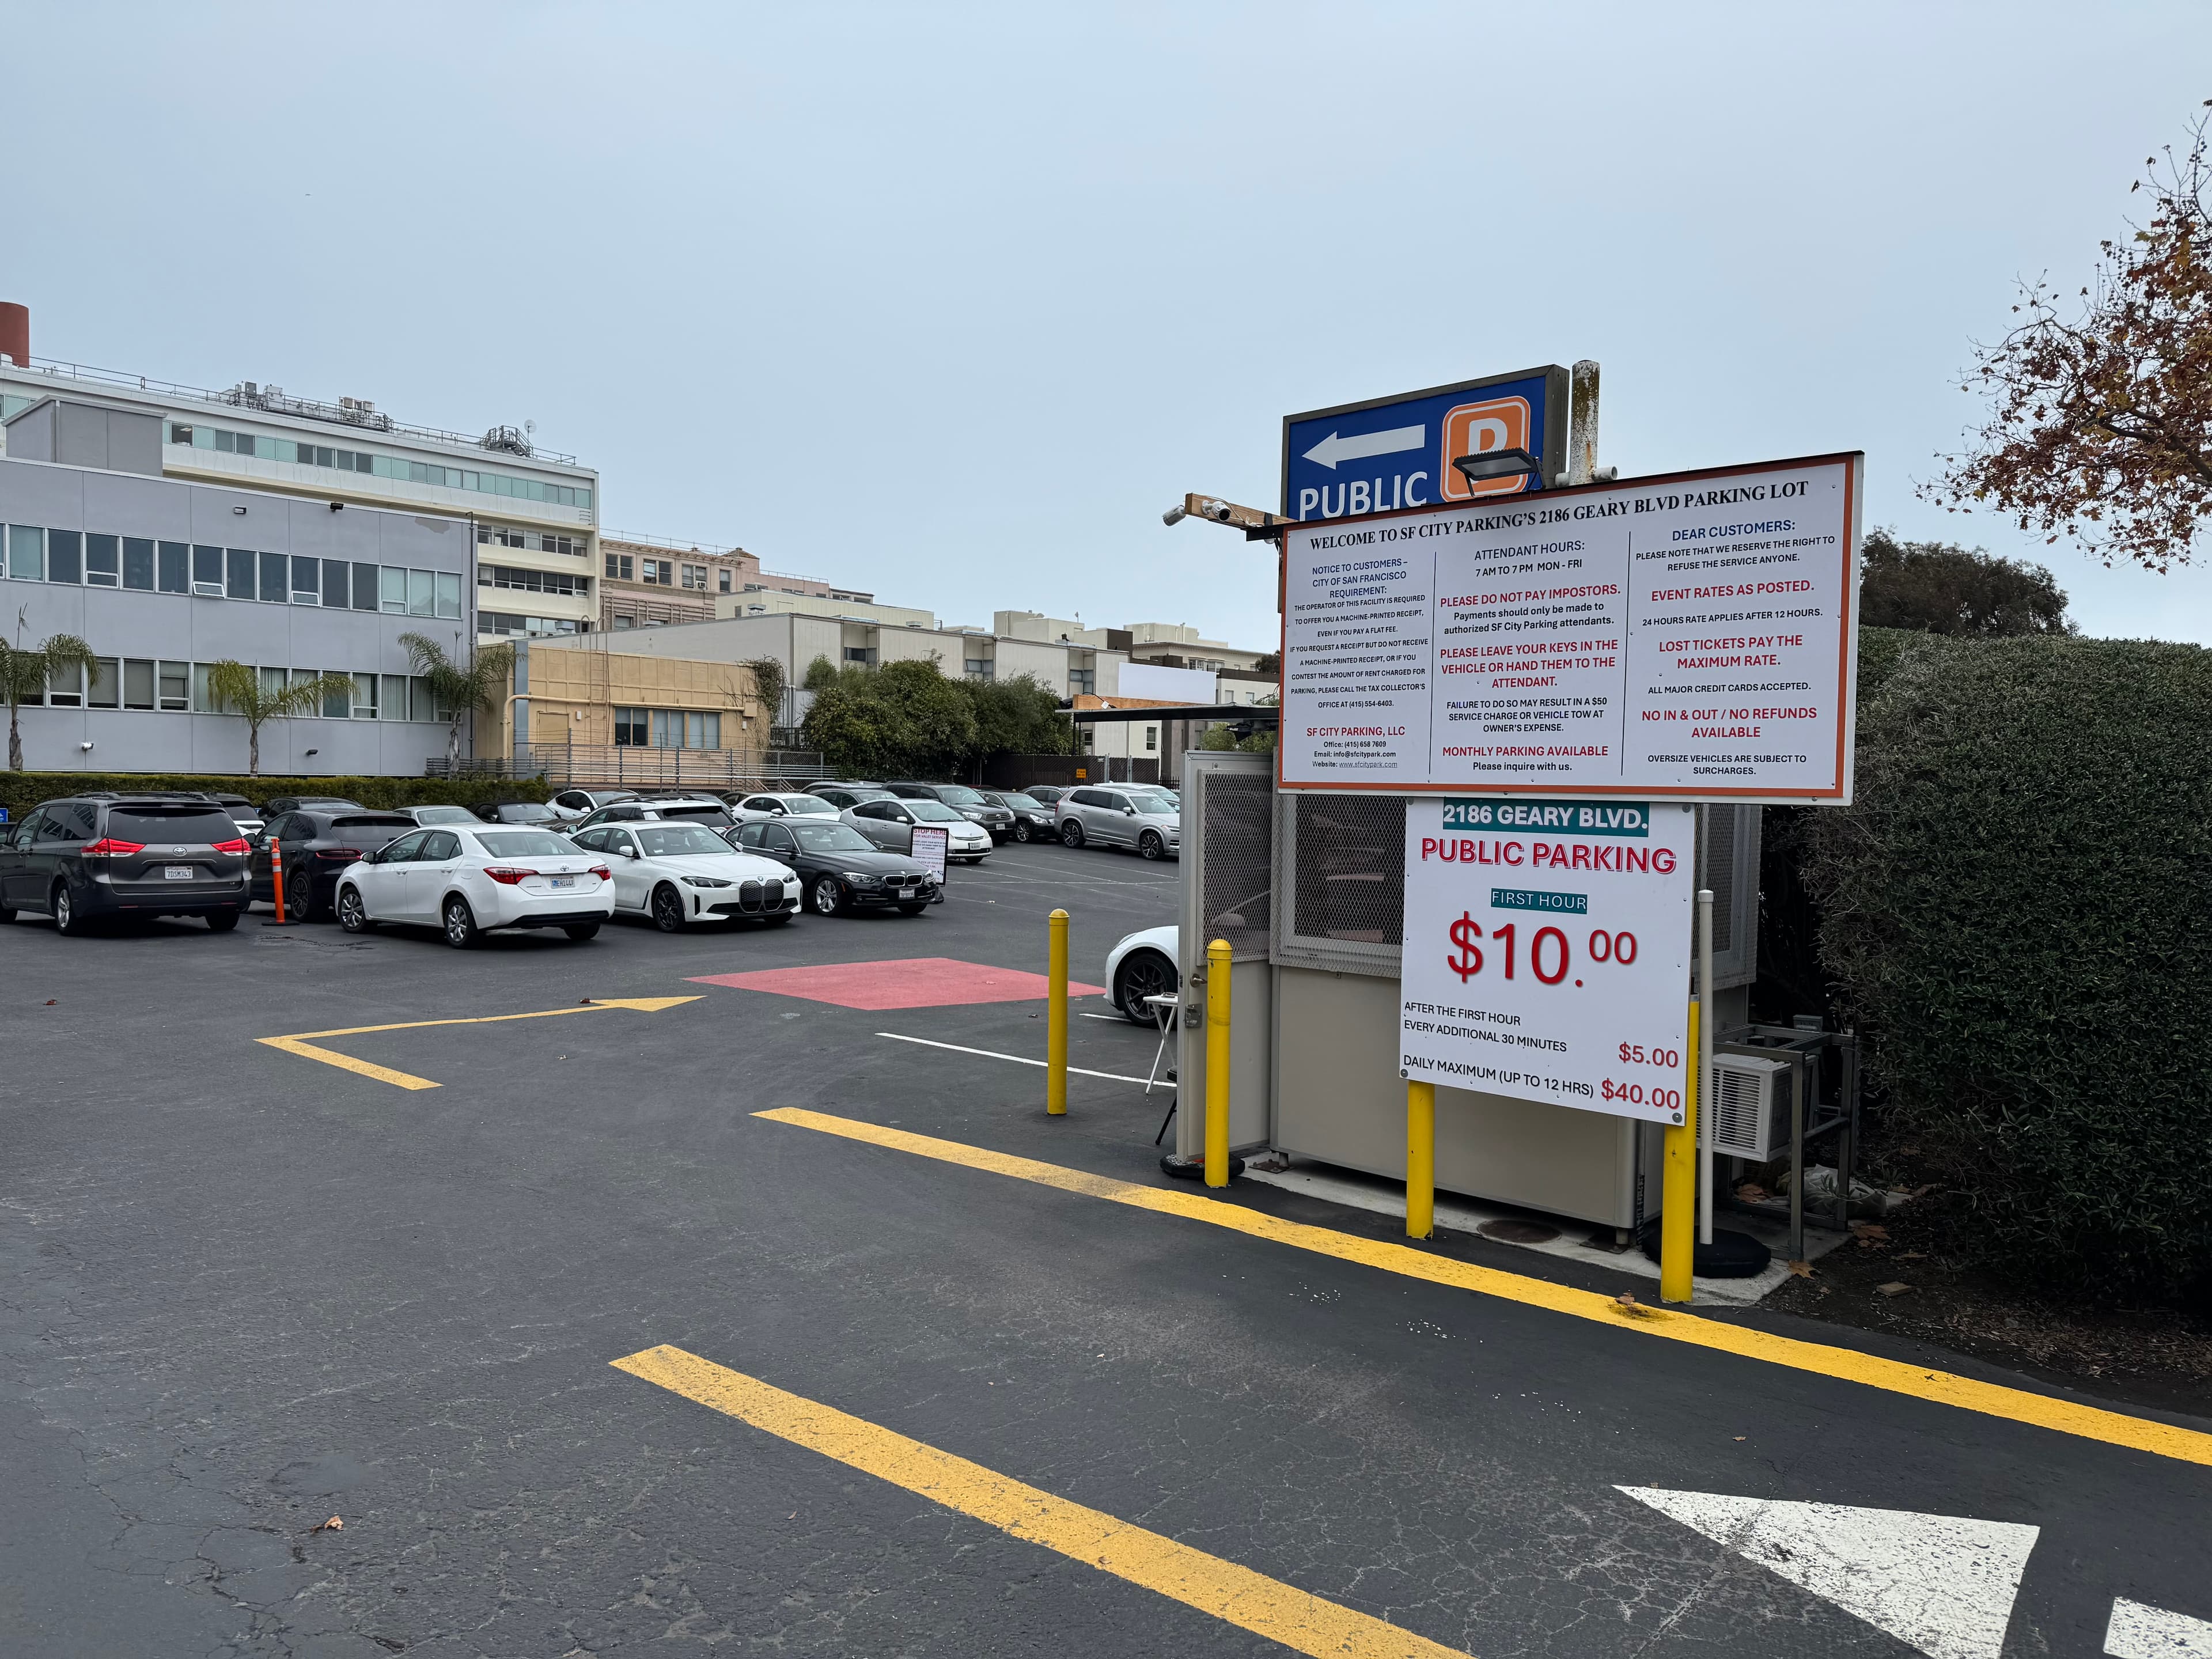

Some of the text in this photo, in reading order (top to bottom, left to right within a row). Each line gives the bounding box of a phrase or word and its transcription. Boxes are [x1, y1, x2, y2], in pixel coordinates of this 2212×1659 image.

[1468, 417, 1508, 484] P
[1300, 471, 1428, 521] PUBLIC
[1310, 480, 1809, 550] WELCOME TO SF CITY PARKING'S 2186 GEARY BLVD PARKING LOT
[1673, 520, 1795, 541] DEAR CUSTOMERS:
[1475, 541, 1584, 560] ATTENDANT HOURS:
[1313, 565, 1339, 574] NOTICE
[1341, 563, 1351, 572] TO
[1354, 559, 1402, 570] CUSTOMERS
[1475, 569, 1481, 577] 7
[1483, 567, 1495, 576] AM
[1498, 566, 1509, 574] TO
[1512, 565, 1517, 574] 7
[1520, 564, 1533, 573] PM
[1537, 561, 1559, 571] MON
[1568, 559, 1582, 568] FRI
[1313, 571, 1406, 587] CITY OF SAN FRANCISCO
[1330, 586, 1387, 599] REQUIREMENT:
[1441, 584, 1620, 607] PLEASE DO NOT PAY IMPOSTORS.
[1652, 580, 1814, 601] EVENT RATES AS POSTED.
[1306, 602, 1336, 611] OPERATOR
[1360, 598, 1386, 606] FACILITY
[1394, 595, 1425, 603] REQUIRED
[1441, 640, 1618, 658] PLEASE LEAVE YOUR KEYS IN THE
[1660, 635, 1802, 652] LOST TICKETS PAY THE
[1442, 657, 1615, 674] VEHICLE OR HAND THEM TO THE
[1678, 654, 1780, 668] MAXIMUM RATE.
[1493, 676, 1557, 688] ATTENDANT.
[1647, 683, 1810, 694] ALL MAJOR CREDIT CARDS ACCEPTED.
[1349, 700, 1364, 709] (415)
[1642, 711, 1660, 721] NO
[1664, 710, 1676, 720] IN
[1680, 710, 1688, 719] &
[1692, 710, 1718, 719] OUT
[1730, 709, 1749, 719] NO
[1753, 707, 1816, 719] REFUNDS
[1307, 726, 1404, 737] SF CITY PARKING, LLC
[1692, 727, 1760, 737] AVAILABLE
[1344, 741, 1359, 749] (415)
[1443, 746, 1608, 756] MONTHLY PARKING AVAILABLE
[1333, 751, 1396, 759] info@sfcitypark.com
[1690, 755, 1733, 763] VEHICLES
[1734, 755, 1752, 763] ARE
[1753, 755, 1793, 763] SUBJECT
[1794, 755, 1806, 763] TO
[1473, 762, 1502, 770] Please
[1504, 762, 1535, 772] inquire
[1537, 762, 1556, 770] with
[1693, 767, 1756, 775] SURCHARGES.
[1443, 802, 1649, 830] 2186 GEARY BLVD.
[1422, 838, 1676, 874] PUBLIC PARKING
[1491, 892, 1586, 909] FIRST HOUR
[1405, 1002, 1520, 1025] AFTER THE FIRST HOUR
[1405, 1020, 1566, 1051] EVERY ADDITIONAL 30 MINUTES
[1619, 1043, 1678, 1067] $5.00
[1404, 1055, 1593, 1099] DAILY MAXIMUM (UP TO 12 HRS)
[1601, 1078, 1680, 1109] $40.00
